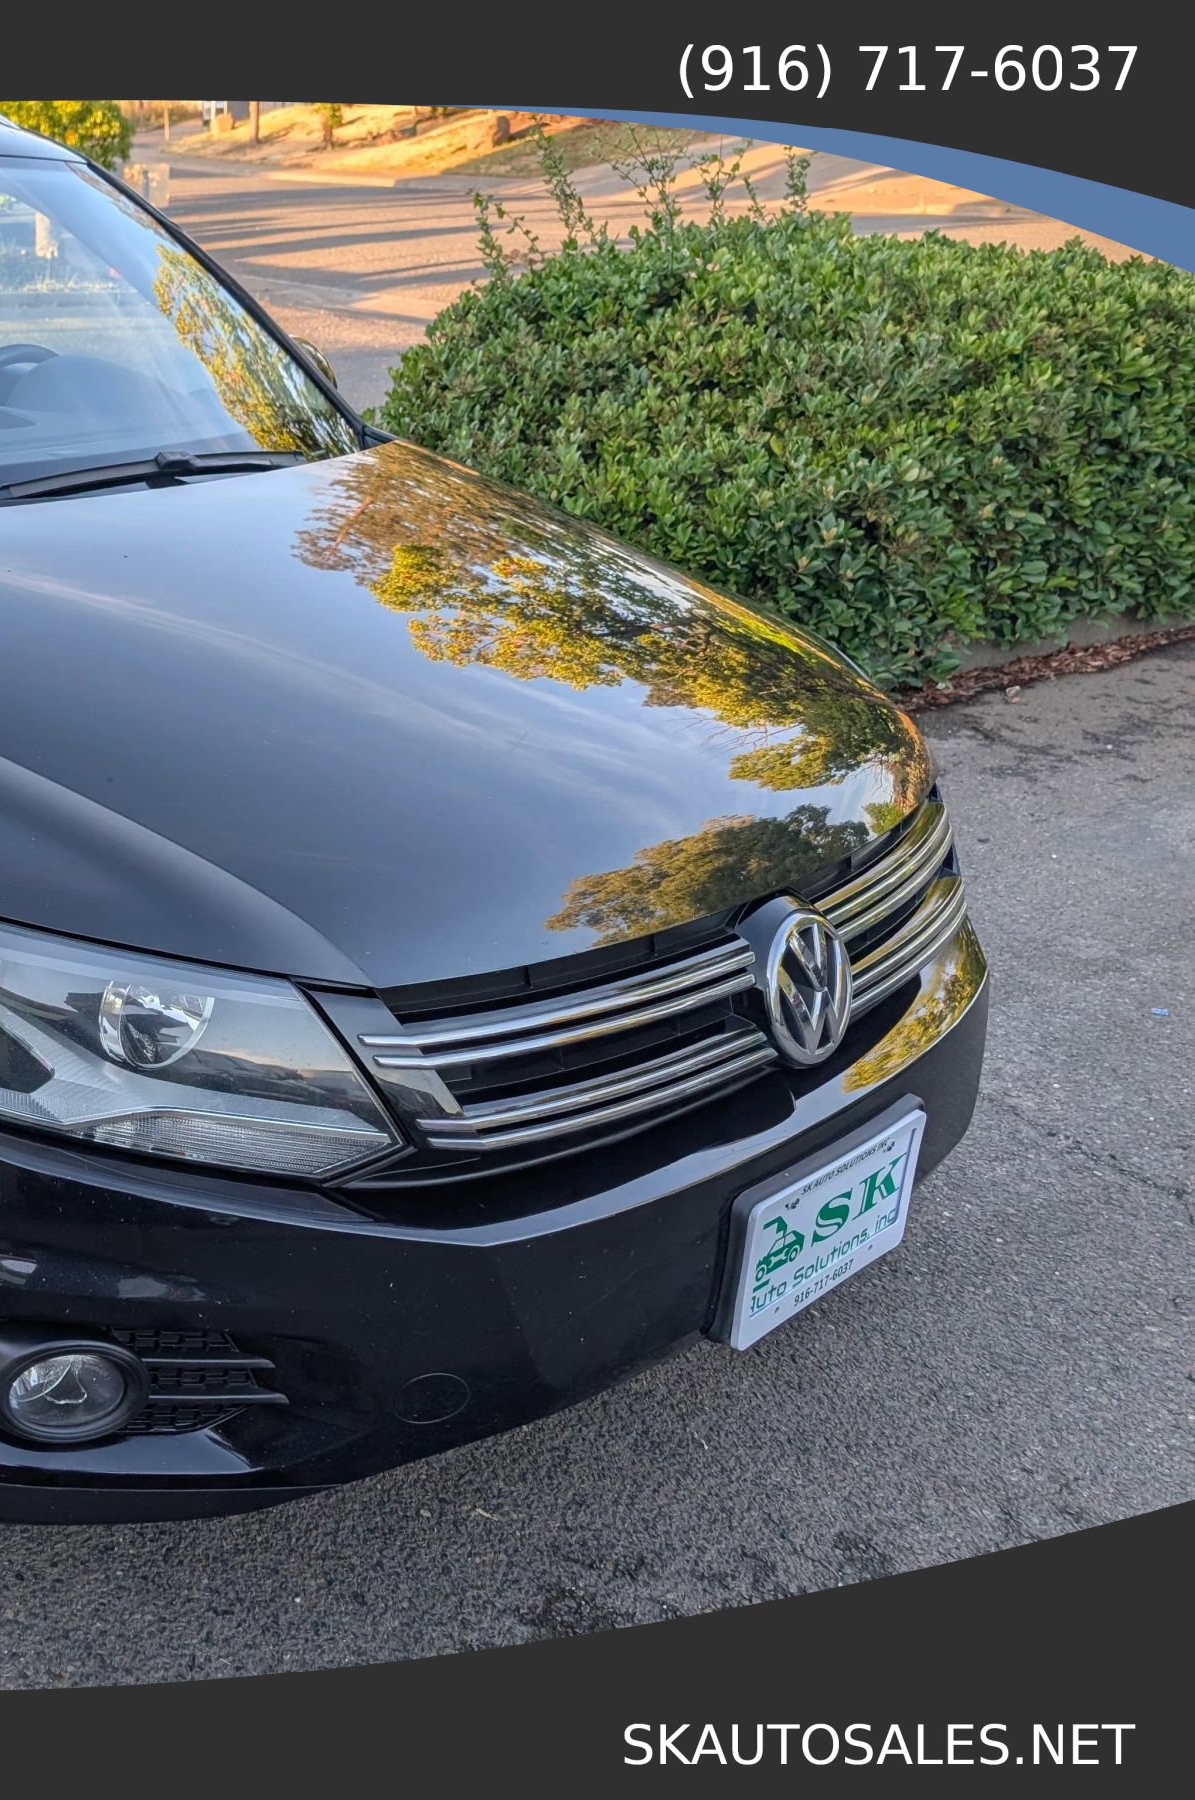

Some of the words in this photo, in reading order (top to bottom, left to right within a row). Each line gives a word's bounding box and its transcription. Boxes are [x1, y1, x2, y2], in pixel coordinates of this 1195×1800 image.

[812, 1172, 835, 1190] AUTO
[834, 1145, 878, 1177] SOLUTIONS
[810, 1151, 908, 1248] SK
[874, 1207, 897, 1234] inc
[793, 1258, 854, 1308] 916-717-6037
